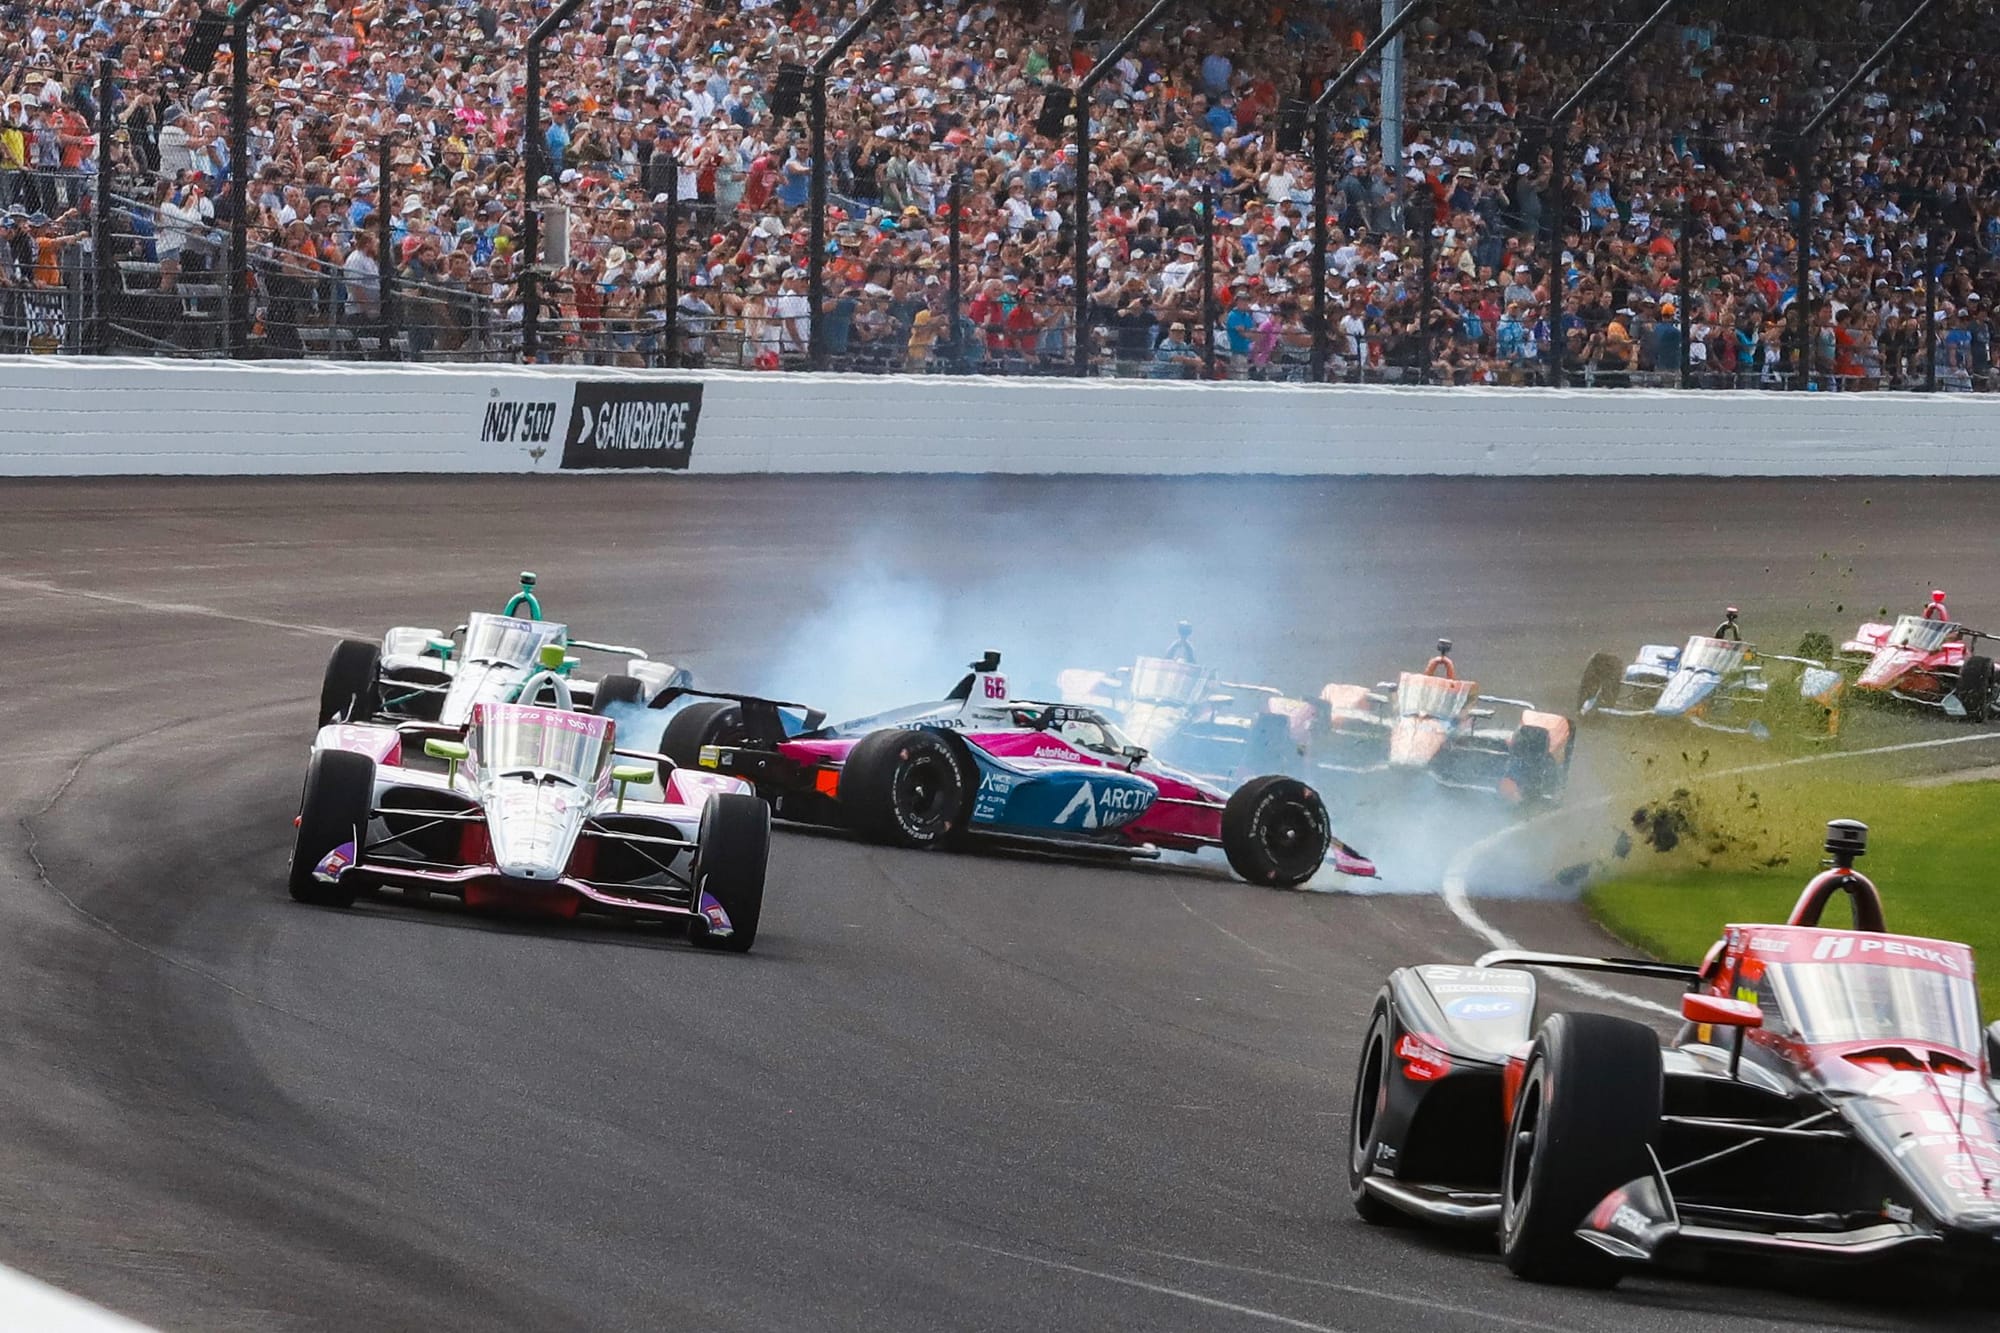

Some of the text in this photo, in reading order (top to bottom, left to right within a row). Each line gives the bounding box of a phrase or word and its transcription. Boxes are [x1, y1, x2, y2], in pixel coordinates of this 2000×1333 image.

[481, 402, 556, 442] INDY 500
[595, 401, 690, 450] GAINBRIDGE
[984, 676, 1006, 700] 66
[1098, 786, 1154, 811] ARCTIC
[1860, 940, 1961, 972] PERKS
